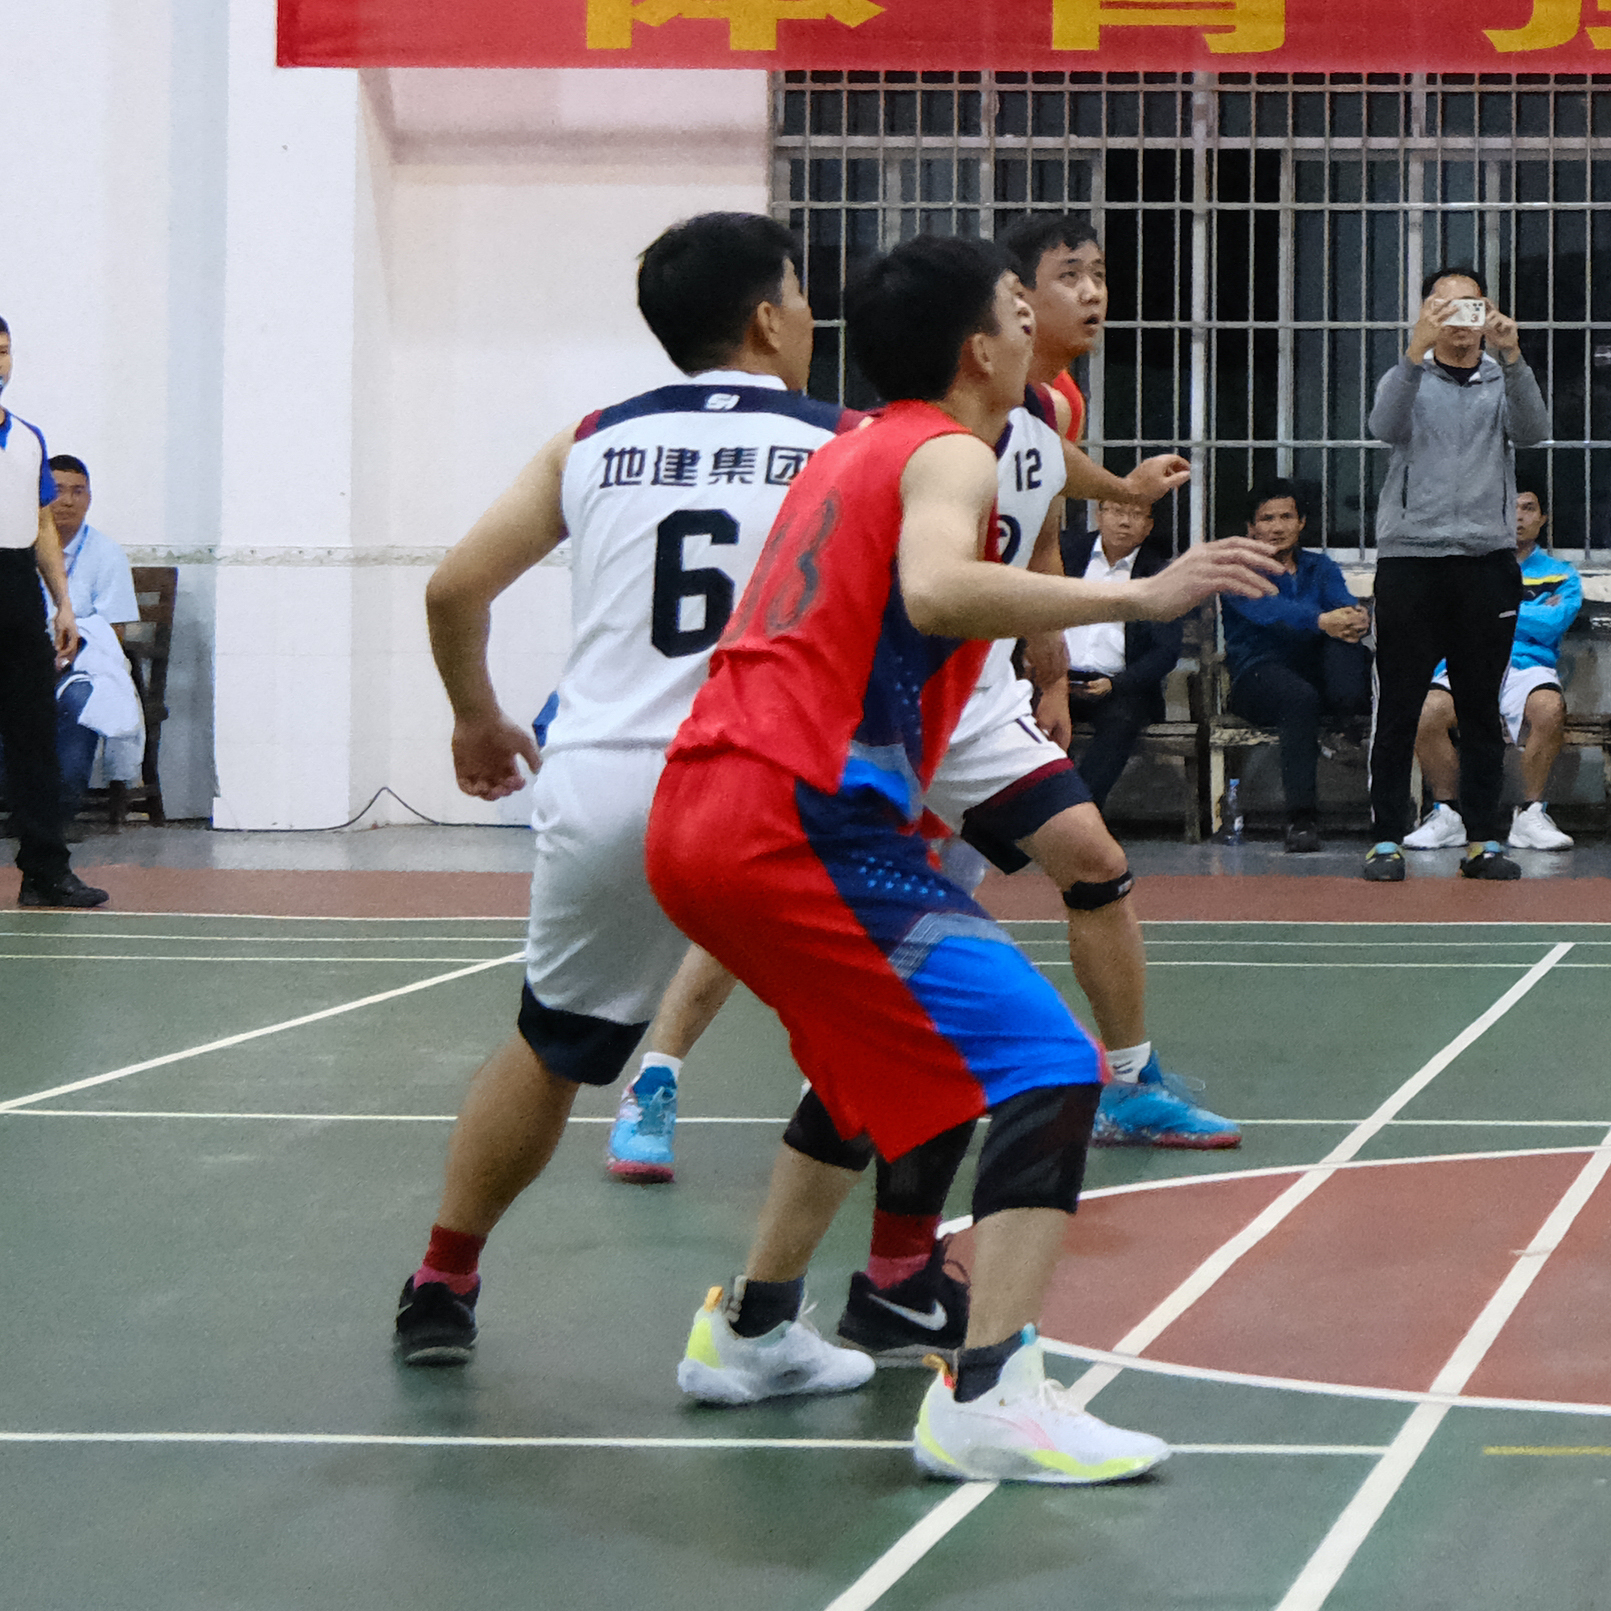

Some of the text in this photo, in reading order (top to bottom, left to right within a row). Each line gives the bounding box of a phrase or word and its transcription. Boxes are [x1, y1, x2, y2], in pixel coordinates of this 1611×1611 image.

[600, 445, 816, 488] 地建集团
[1014, 448, 1042, 492] 12
[651, 508, 741, 658] 6
